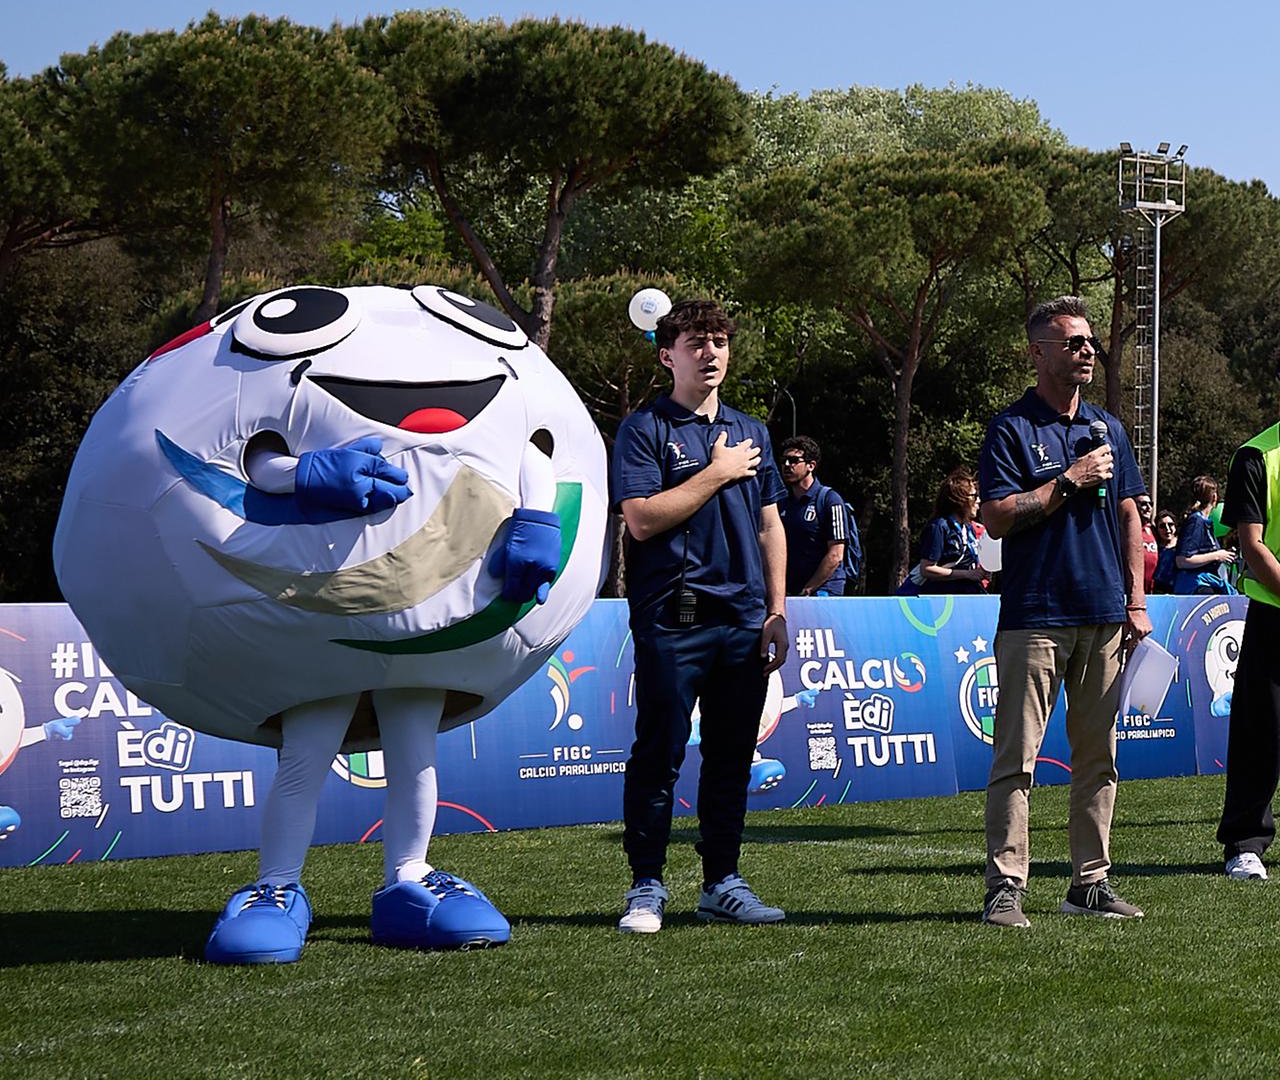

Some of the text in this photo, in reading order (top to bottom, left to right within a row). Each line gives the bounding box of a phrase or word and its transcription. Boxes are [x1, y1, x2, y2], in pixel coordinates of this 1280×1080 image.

[795, 628, 845, 659] #IL
[54, 681, 160, 719] CAL
[1123, 714, 1151, 727] FIGC
[1127, 728, 1175, 740] PARALIMPICO
[553, 745, 592, 761] FIGC
[847, 733, 936, 767] TUTTI
[519, 762, 626, 779] CALCIO PARALIMPICO
[120, 771, 254, 813] TUTTI
